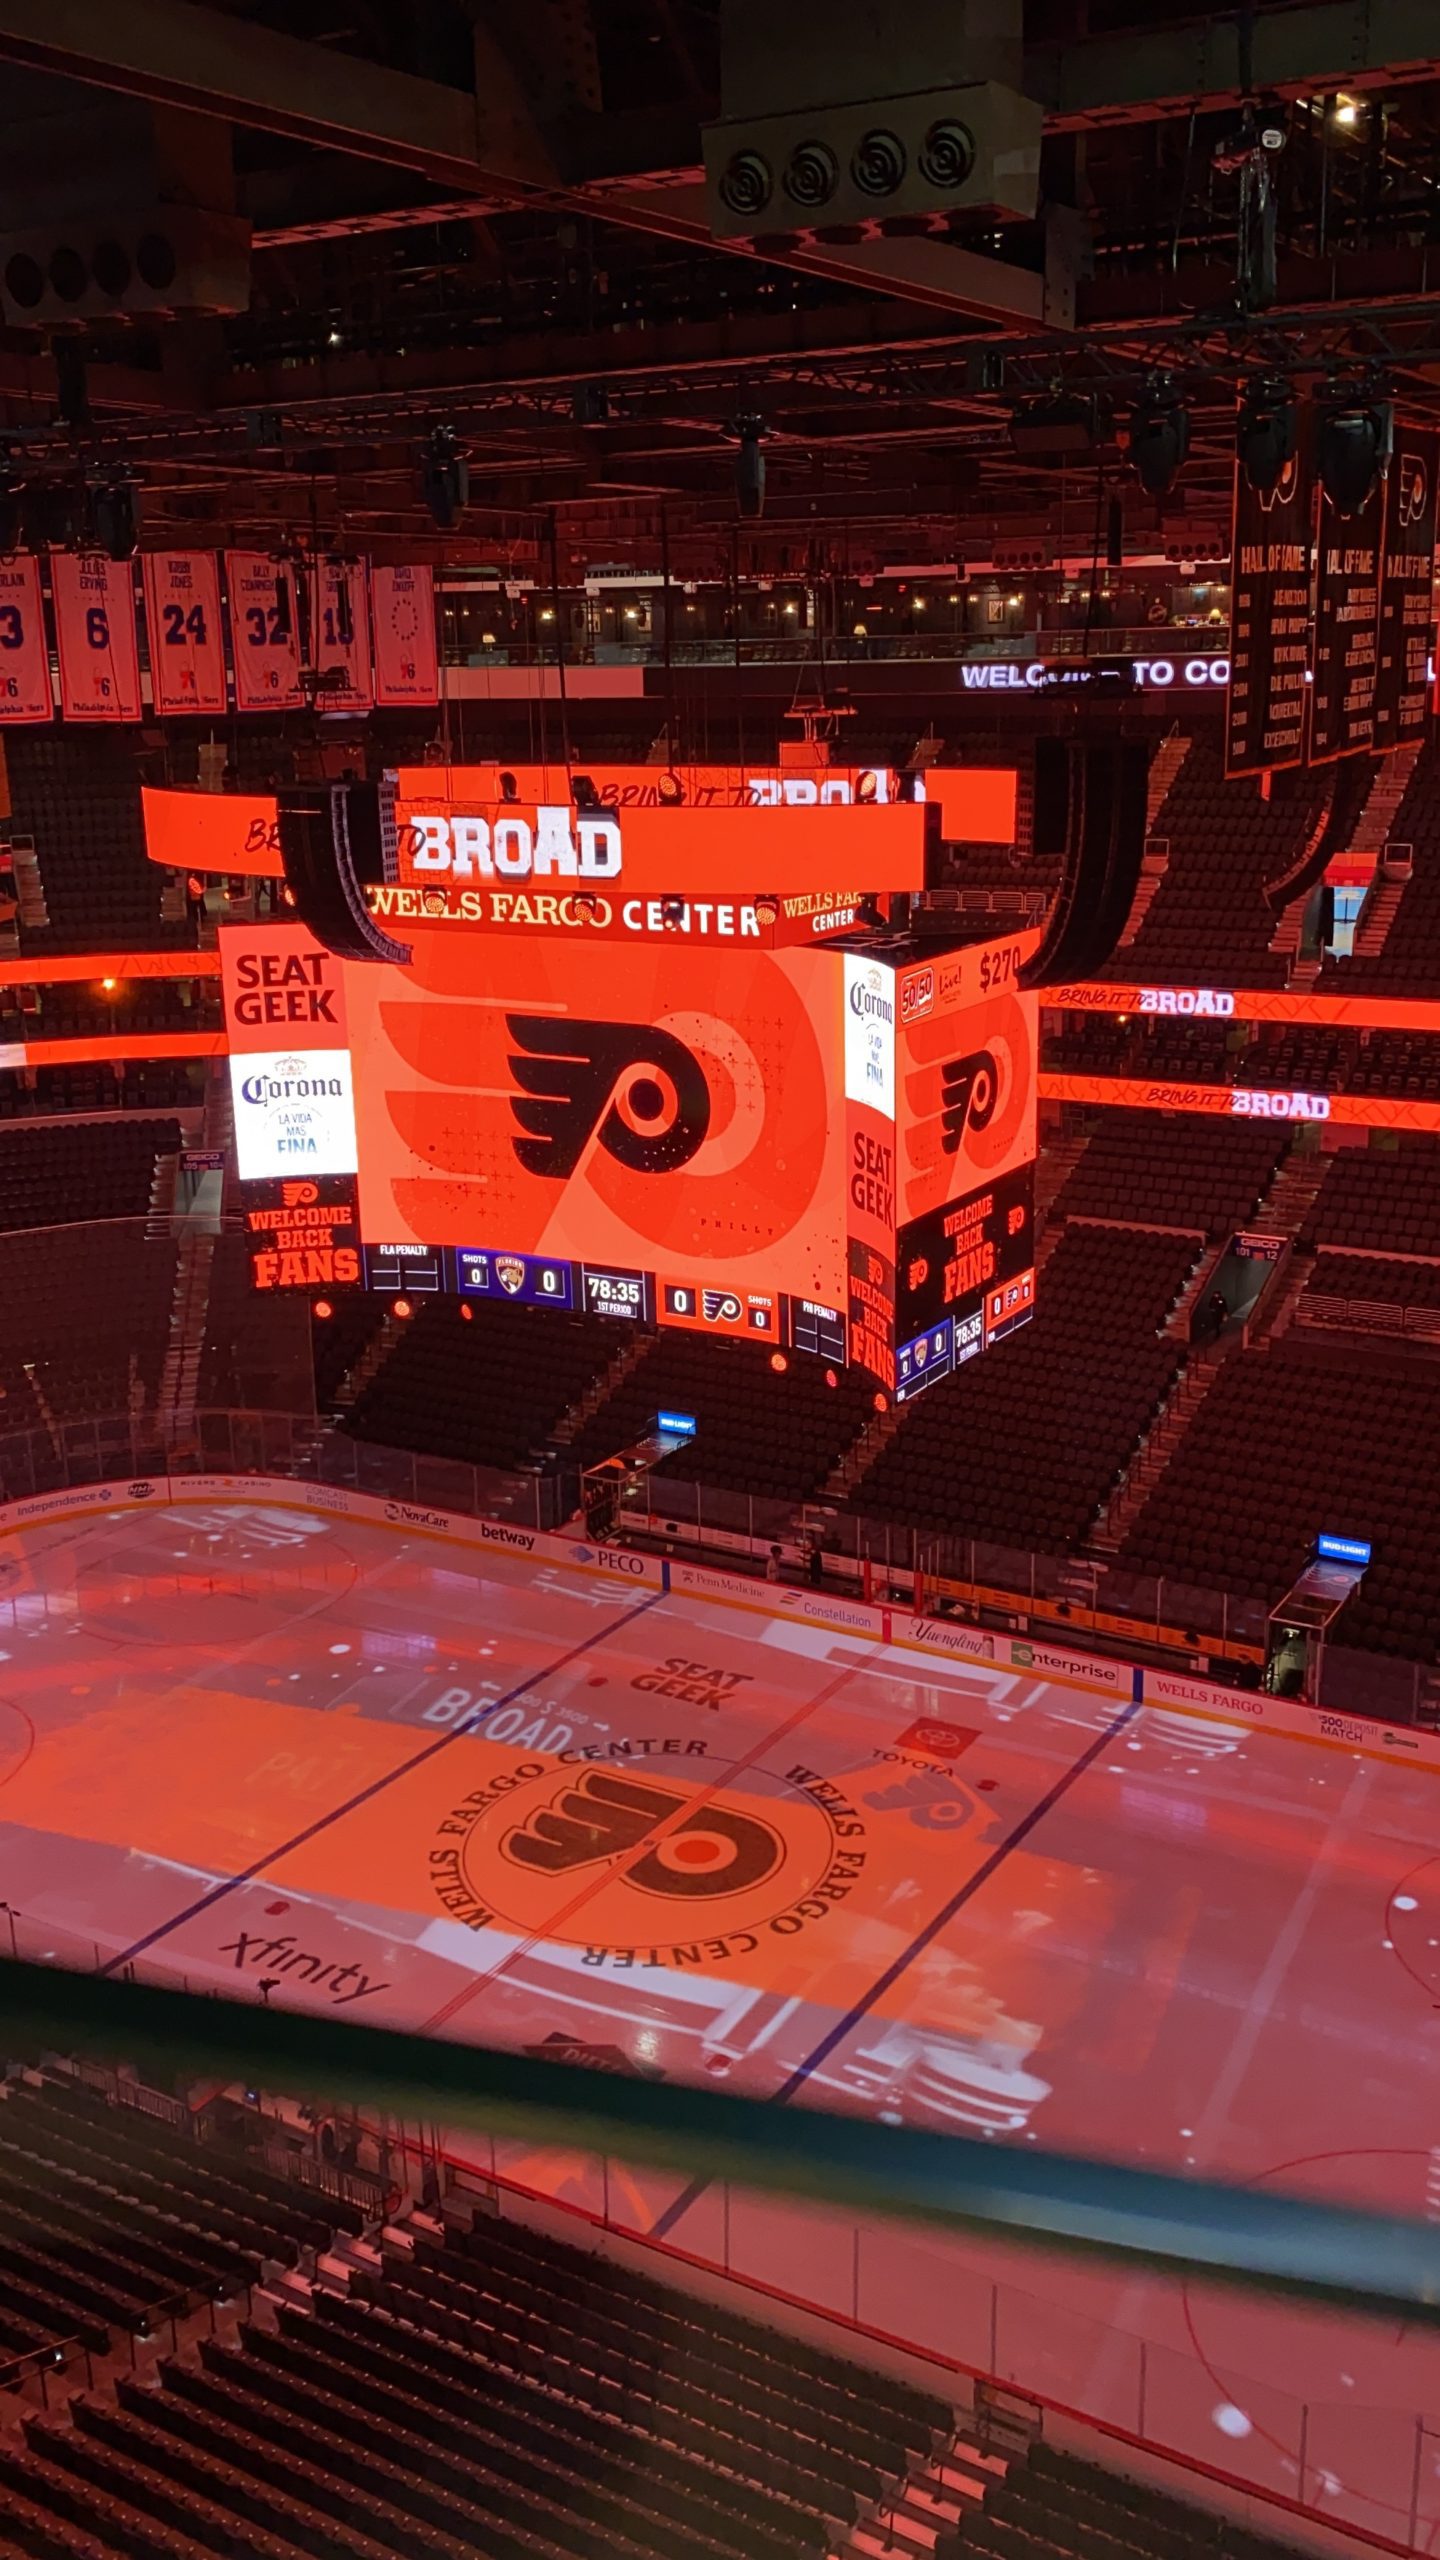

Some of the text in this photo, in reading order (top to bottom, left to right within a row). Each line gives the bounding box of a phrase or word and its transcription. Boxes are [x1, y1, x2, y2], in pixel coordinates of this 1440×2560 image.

[86, 608, 109, 649] 6
[163, 604, 207, 645] 24
[246, 607, 288, 646] 32
[1133, 661, 1174, 686] TO
[410, 806, 622, 878] BROAD
[367, 886, 761, 937] WELLS FARGO CENTER
[783, 891, 834, 919] WELLS
[812, 908, 855, 932] CENTER
[236, 952, 330, 990] SEAT
[850, 981, 893, 1025] Corona
[902, 973, 932, 1013] 50/50
[1058, 988, 1148, 1009] BRING IT TO
[1140, 989, 1234, 1016] BROAD
[233, 989, 339, 1026] GEEK
[241, 1075, 343, 1107] Corona
[1147, 1088, 1239, 1110] BRING IT TO
[1232, 1091, 1330, 1119] BROAD
[279, 1112, 313, 1125] LA VIDA
[277, 1138, 318, 1153] FINA
[853, 1131, 892, 1185] SEAT
[851, 1173, 893, 1233] GEEK
[944, 1194, 993, 1238] WELCOME
[248, 1206, 352, 1232] WELCOME
[277, 1228, 333, 1249] BACK
[380, 1244, 428, 1257] FLA PENALTY
[955, 1223, 983, 1255] BACK
[1241, 1238, 1280, 1249] GEICO
[254, 1248, 360, 1288] FANS
[462, 1254, 487, 1265] SHOTS
[944, 1241, 994, 1303] FANS
[471, 1268, 556, 1292] 0 0
[588, 1277, 640, 1302] 78:35
[609, 1302, 632, 1316] PERIOD
[673, 1290, 688, 1313] 0
[747, 1295, 772, 1307] SHOTS
[814, 1304, 838, 1321] PENALTY
[850, 1276, 895, 1323] WELCOME
[994, 1296, 1001, 1316] 0
[755, 1311, 765, 1328] 0
[863, 1306, 888, 1341] BACK
[955, 1316, 983, 1348] 78:35
[935, 1332, 943, 1352] 0
[851, 1322, 896, 1392] FANS
[17, 1490, 97, 1517] Independence
[306, 1485, 348, 1500] COMCAST
[306, 1495, 349, 1512] BUSINESS
[400, 1505, 449, 1529] NovaCare
[481, 1523, 535, 1551] betway
[1322, 1540, 1367, 1556] BUD LIGHT
[598, 1549, 645, 1576] PECO
[696, 1573, 766, 1599] Penn Medicine
[804, 1601, 872, 1629] Constellation
[908, 1616, 984, 1655] Yuengling
[654, 1658, 755, 1691] SEAT
[1017, 1645, 1116, 1682] enterprise
[629, 1674, 736, 1713] GEEK
[1157, 1680, 1264, 1716] WELLS FARGO
[423, 1687, 574, 1755] BROAD
[1320, 1725, 1363, 1742] MATCH
[1343, 1721, 1379, 1736] DEPOSIT
[872, 1748, 954, 1777] TOYOTA
[430, 1738, 709, 1932] WELLS FARGO CENTER
[581, 1764, 867, 1969] WELLS FARGO CENTER
